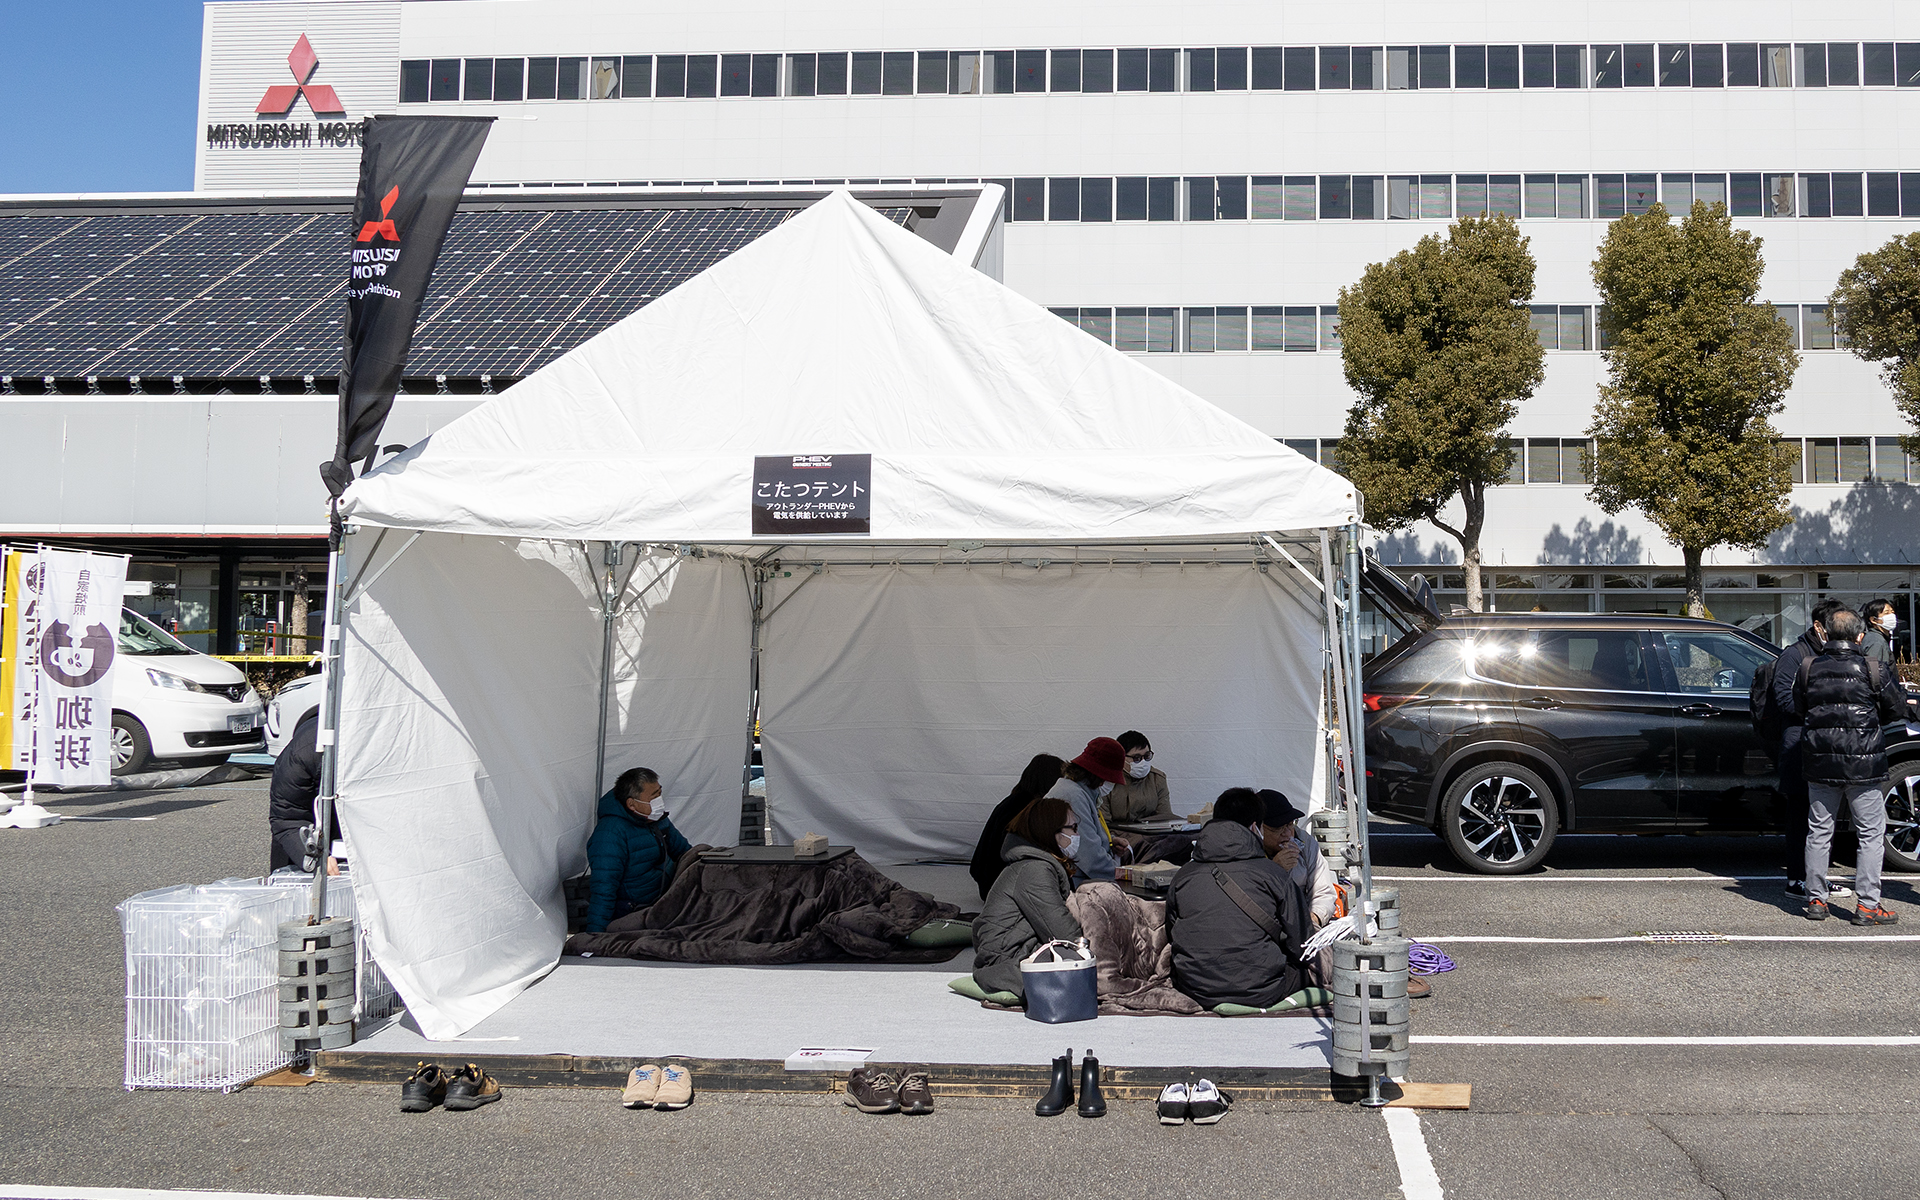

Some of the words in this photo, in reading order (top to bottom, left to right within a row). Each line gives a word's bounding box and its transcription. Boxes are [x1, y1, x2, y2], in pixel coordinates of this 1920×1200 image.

[206, 122, 311, 142] MITSUBISHI
[318, 122, 364, 141] MOTO
[757, 480, 865, 498] こたつテント
[766, 502, 856, 511] アウトランダーPHEVから
[773, 511, 849, 520] 電気を供給しています
